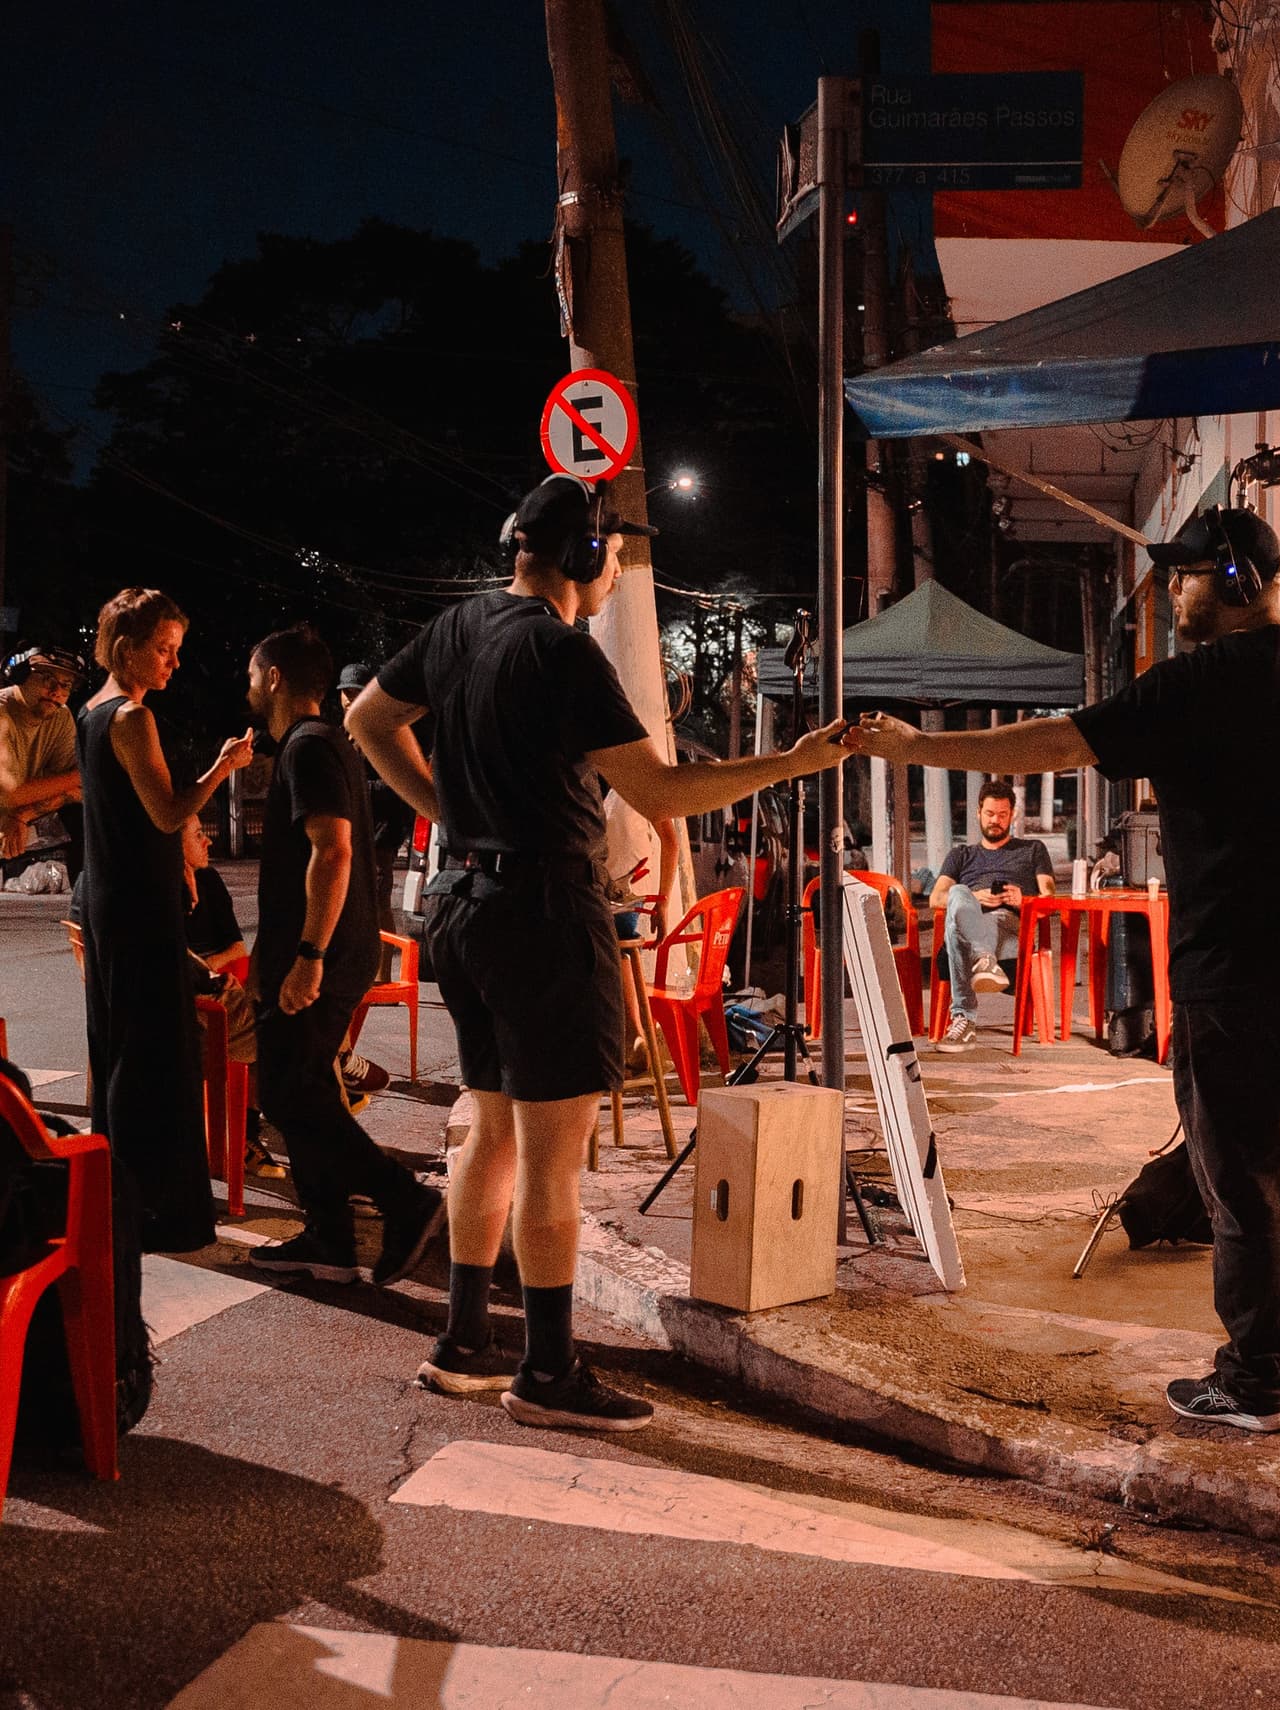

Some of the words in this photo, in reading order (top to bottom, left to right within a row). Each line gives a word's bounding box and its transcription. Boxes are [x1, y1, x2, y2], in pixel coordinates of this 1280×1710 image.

[870, 84, 911, 105] Rua
[868, 107, 988, 128] Guimarães
[996, 105, 1075, 127] Passos
[1177, 108, 1215, 132] SKY
[915, 171, 926, 184] a
[936, 168, 970, 184] 415
[571, 396, 605, 462] E
